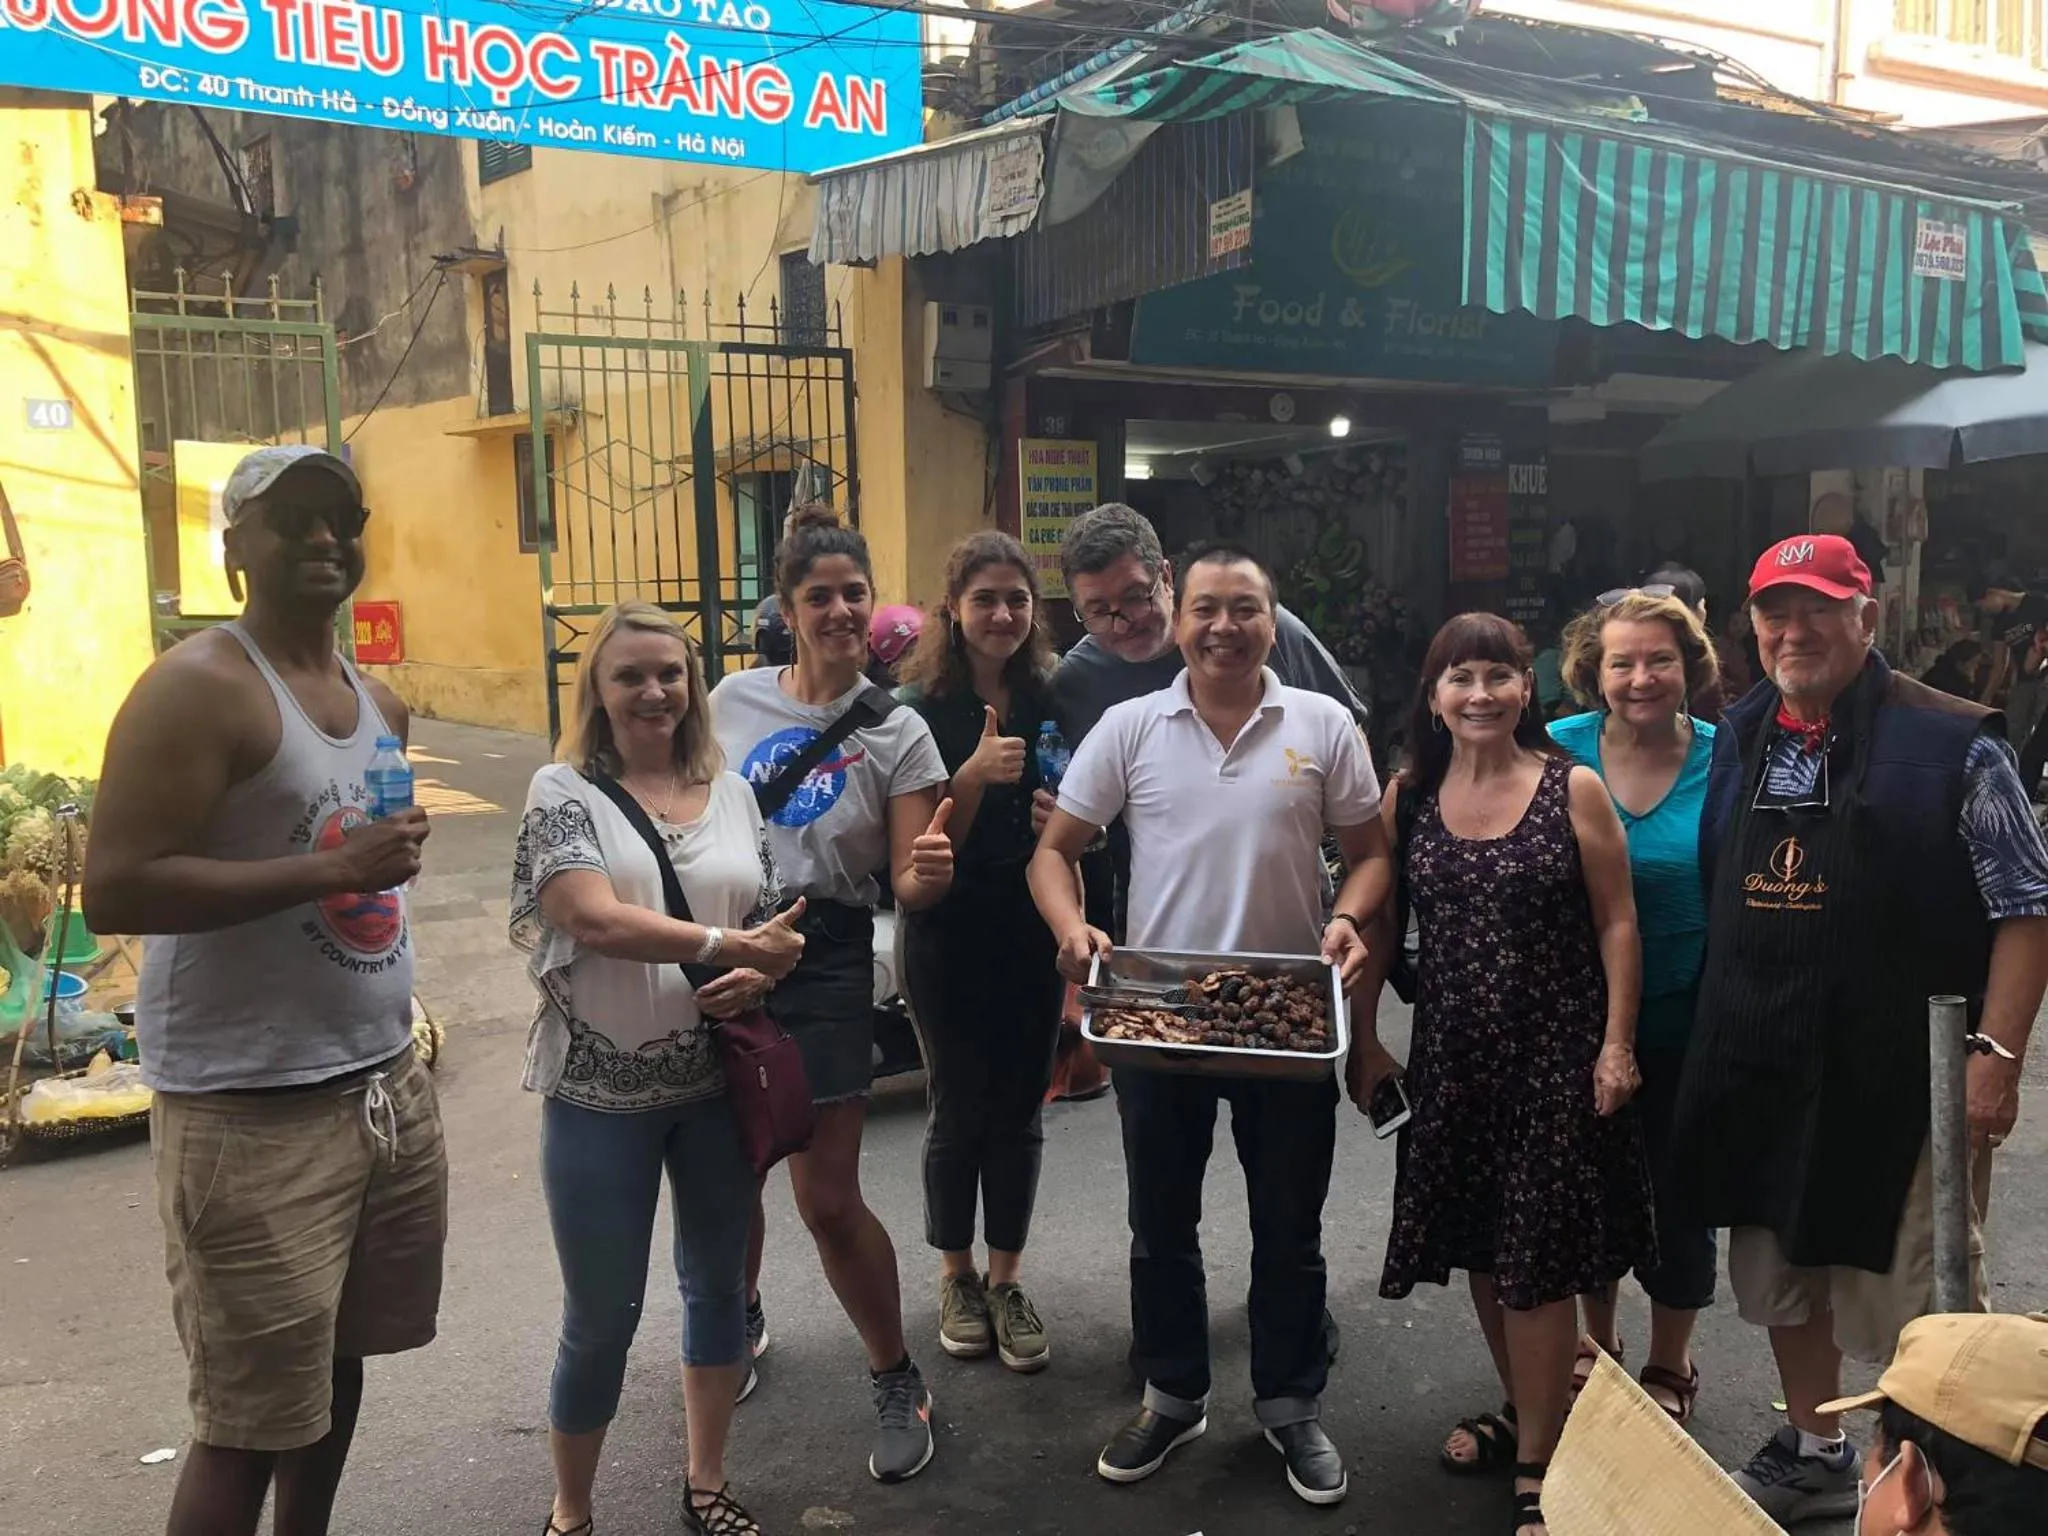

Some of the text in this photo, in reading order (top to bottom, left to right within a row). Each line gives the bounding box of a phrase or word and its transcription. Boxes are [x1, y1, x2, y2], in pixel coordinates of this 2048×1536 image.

[426, 20, 580, 106] HỌC
[591, 30, 793, 123] TRÀNG
[806, 72, 886, 135] AN
[139, 66, 189, 93] ĐC:
[197, 74, 229, 98] 40
[237, 77, 315, 109] Thanh
[321, 86, 358, 114] Hà
[383, 93, 448, 130] Đồng
[455, 106, 516, 134] Xuân
[538, 118, 597, 142] Hoàn
[603, 119, 657, 149] Kiếm
[677, 132, 706, 154] Hà
[710, 137, 746, 159] Nội
[1232, 284, 1324, 329] Food
[1338, 296, 1365, 328] &
[1385, 297, 1490, 340] Florist
[33, 402, 66, 426] 40
[1741, 872, 1829, 901] Duong's
[301, 921, 325, 942] MY
[320, 942, 384, 974] COUNTRY
